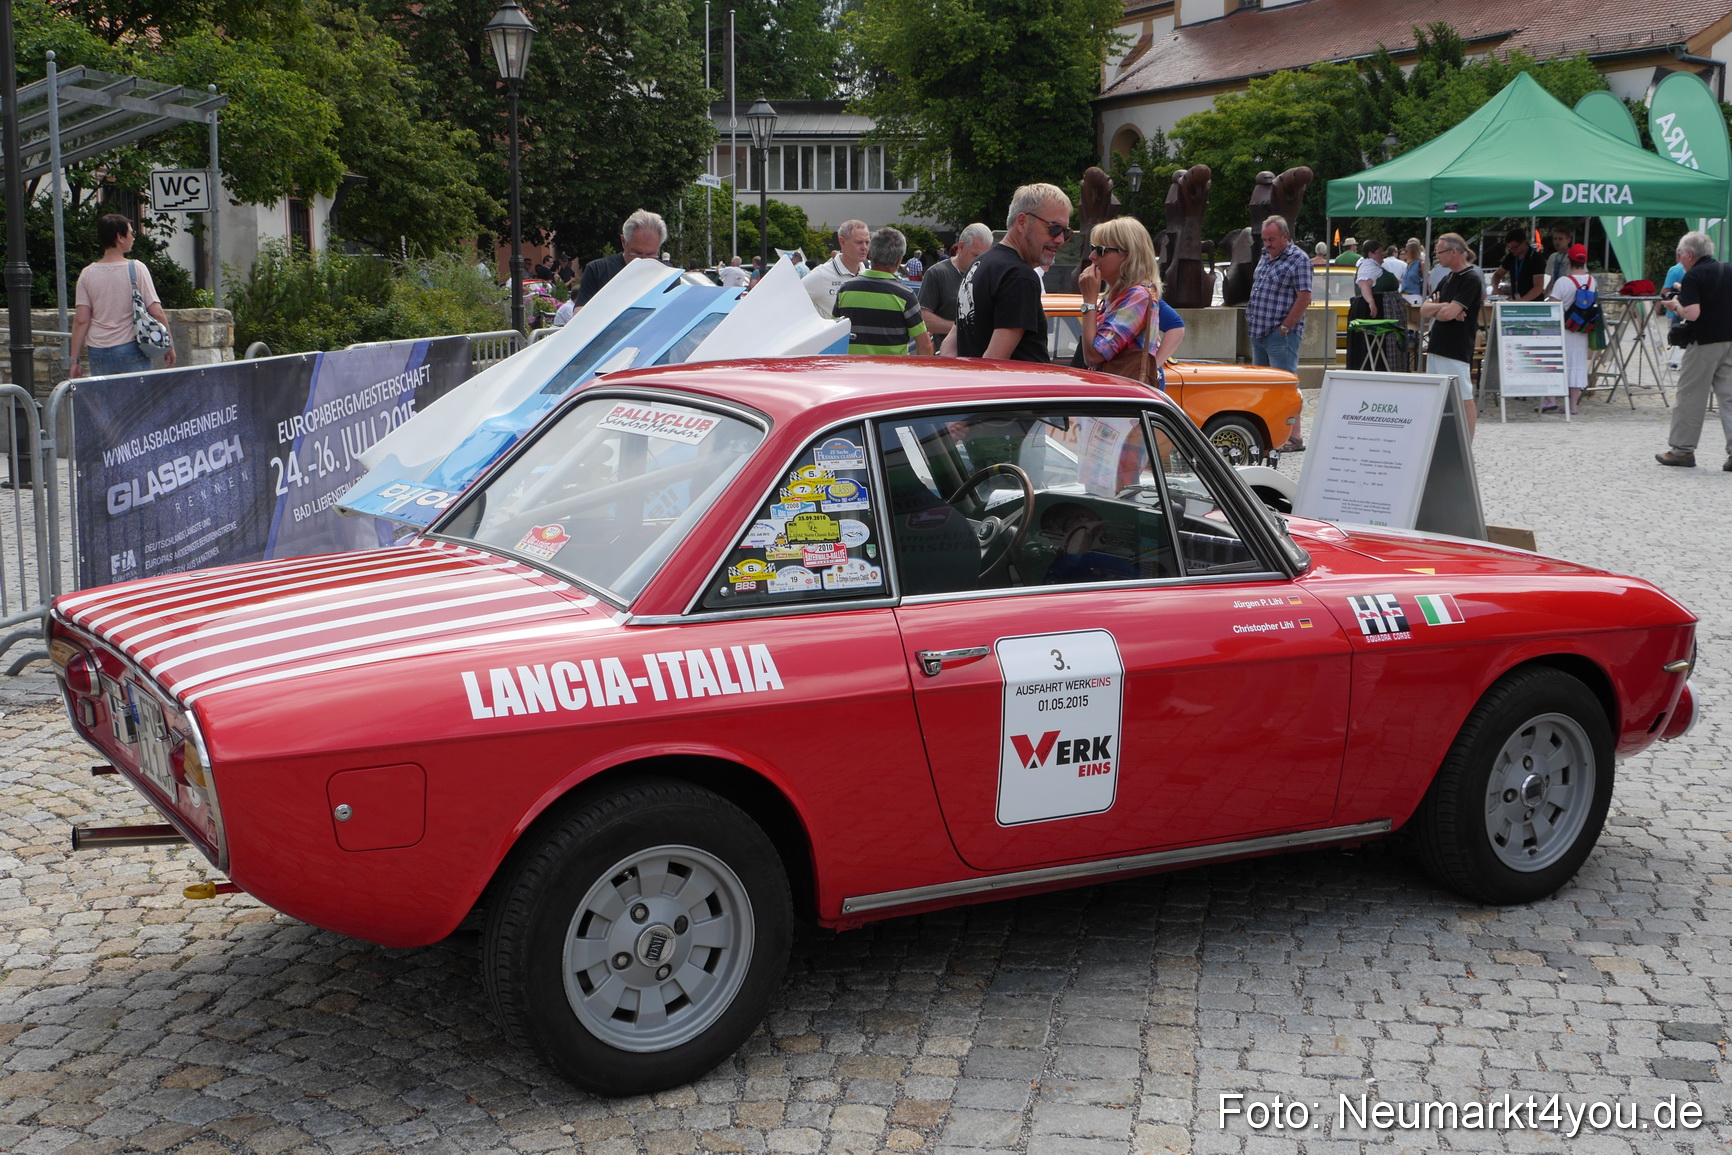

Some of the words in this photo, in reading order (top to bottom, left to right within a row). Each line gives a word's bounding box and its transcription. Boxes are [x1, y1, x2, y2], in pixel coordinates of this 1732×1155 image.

[159, 176, 201, 196] WC
[1366, 185, 1393, 205] DEKRA
[1561, 183, 1634, 205] DEKRA
[278, 364, 431, 444] EUROPABERGMEISTERSCHAFT
[1371, 403, 1398, 414] DEKRA
[611, 406, 714, 431] RALLYCLUB
[1341, 414, 1413, 425] RENNFAHRZEUGSCHAU
[102, 404, 238, 468] WWW.GLASBACHRENNEN.DE
[107, 434, 245, 515] GLASBACH
[270, 435, 341, 497] 24.-26.
[174, 470, 249, 514] RENNEN
[293, 503, 312, 523] BAD
[818, 543, 833, 552] 2010
[145, 552, 174, 570] EUROPAS
[735, 581, 757, 592] BBS
[1233, 599, 1260, 609] Jürgen
[1261, 598, 1268, 607] P.
[1269, 598, 1284, 606] Lihl
[1347, 594, 1408, 635] HF
[1233, 622, 1279, 634] Christopher
[1281, 620, 1295, 630] Lihl
[1365, 633, 1392, 643] SQUADRA
[1392, 632, 1412, 641] CORSE
[1050, 649, 1071, 671] 3.
[461, 644, 785, 720] LANCIA-ITALIA
[1015, 682, 1063, 696] AUSFAHRT
[1065, 677, 1111, 691] WERKEINS
[1038, 695, 1089, 712] 01.05.2015
[1009, 730, 1112, 770] WERK
[1078, 762, 1111, 777] EINS
